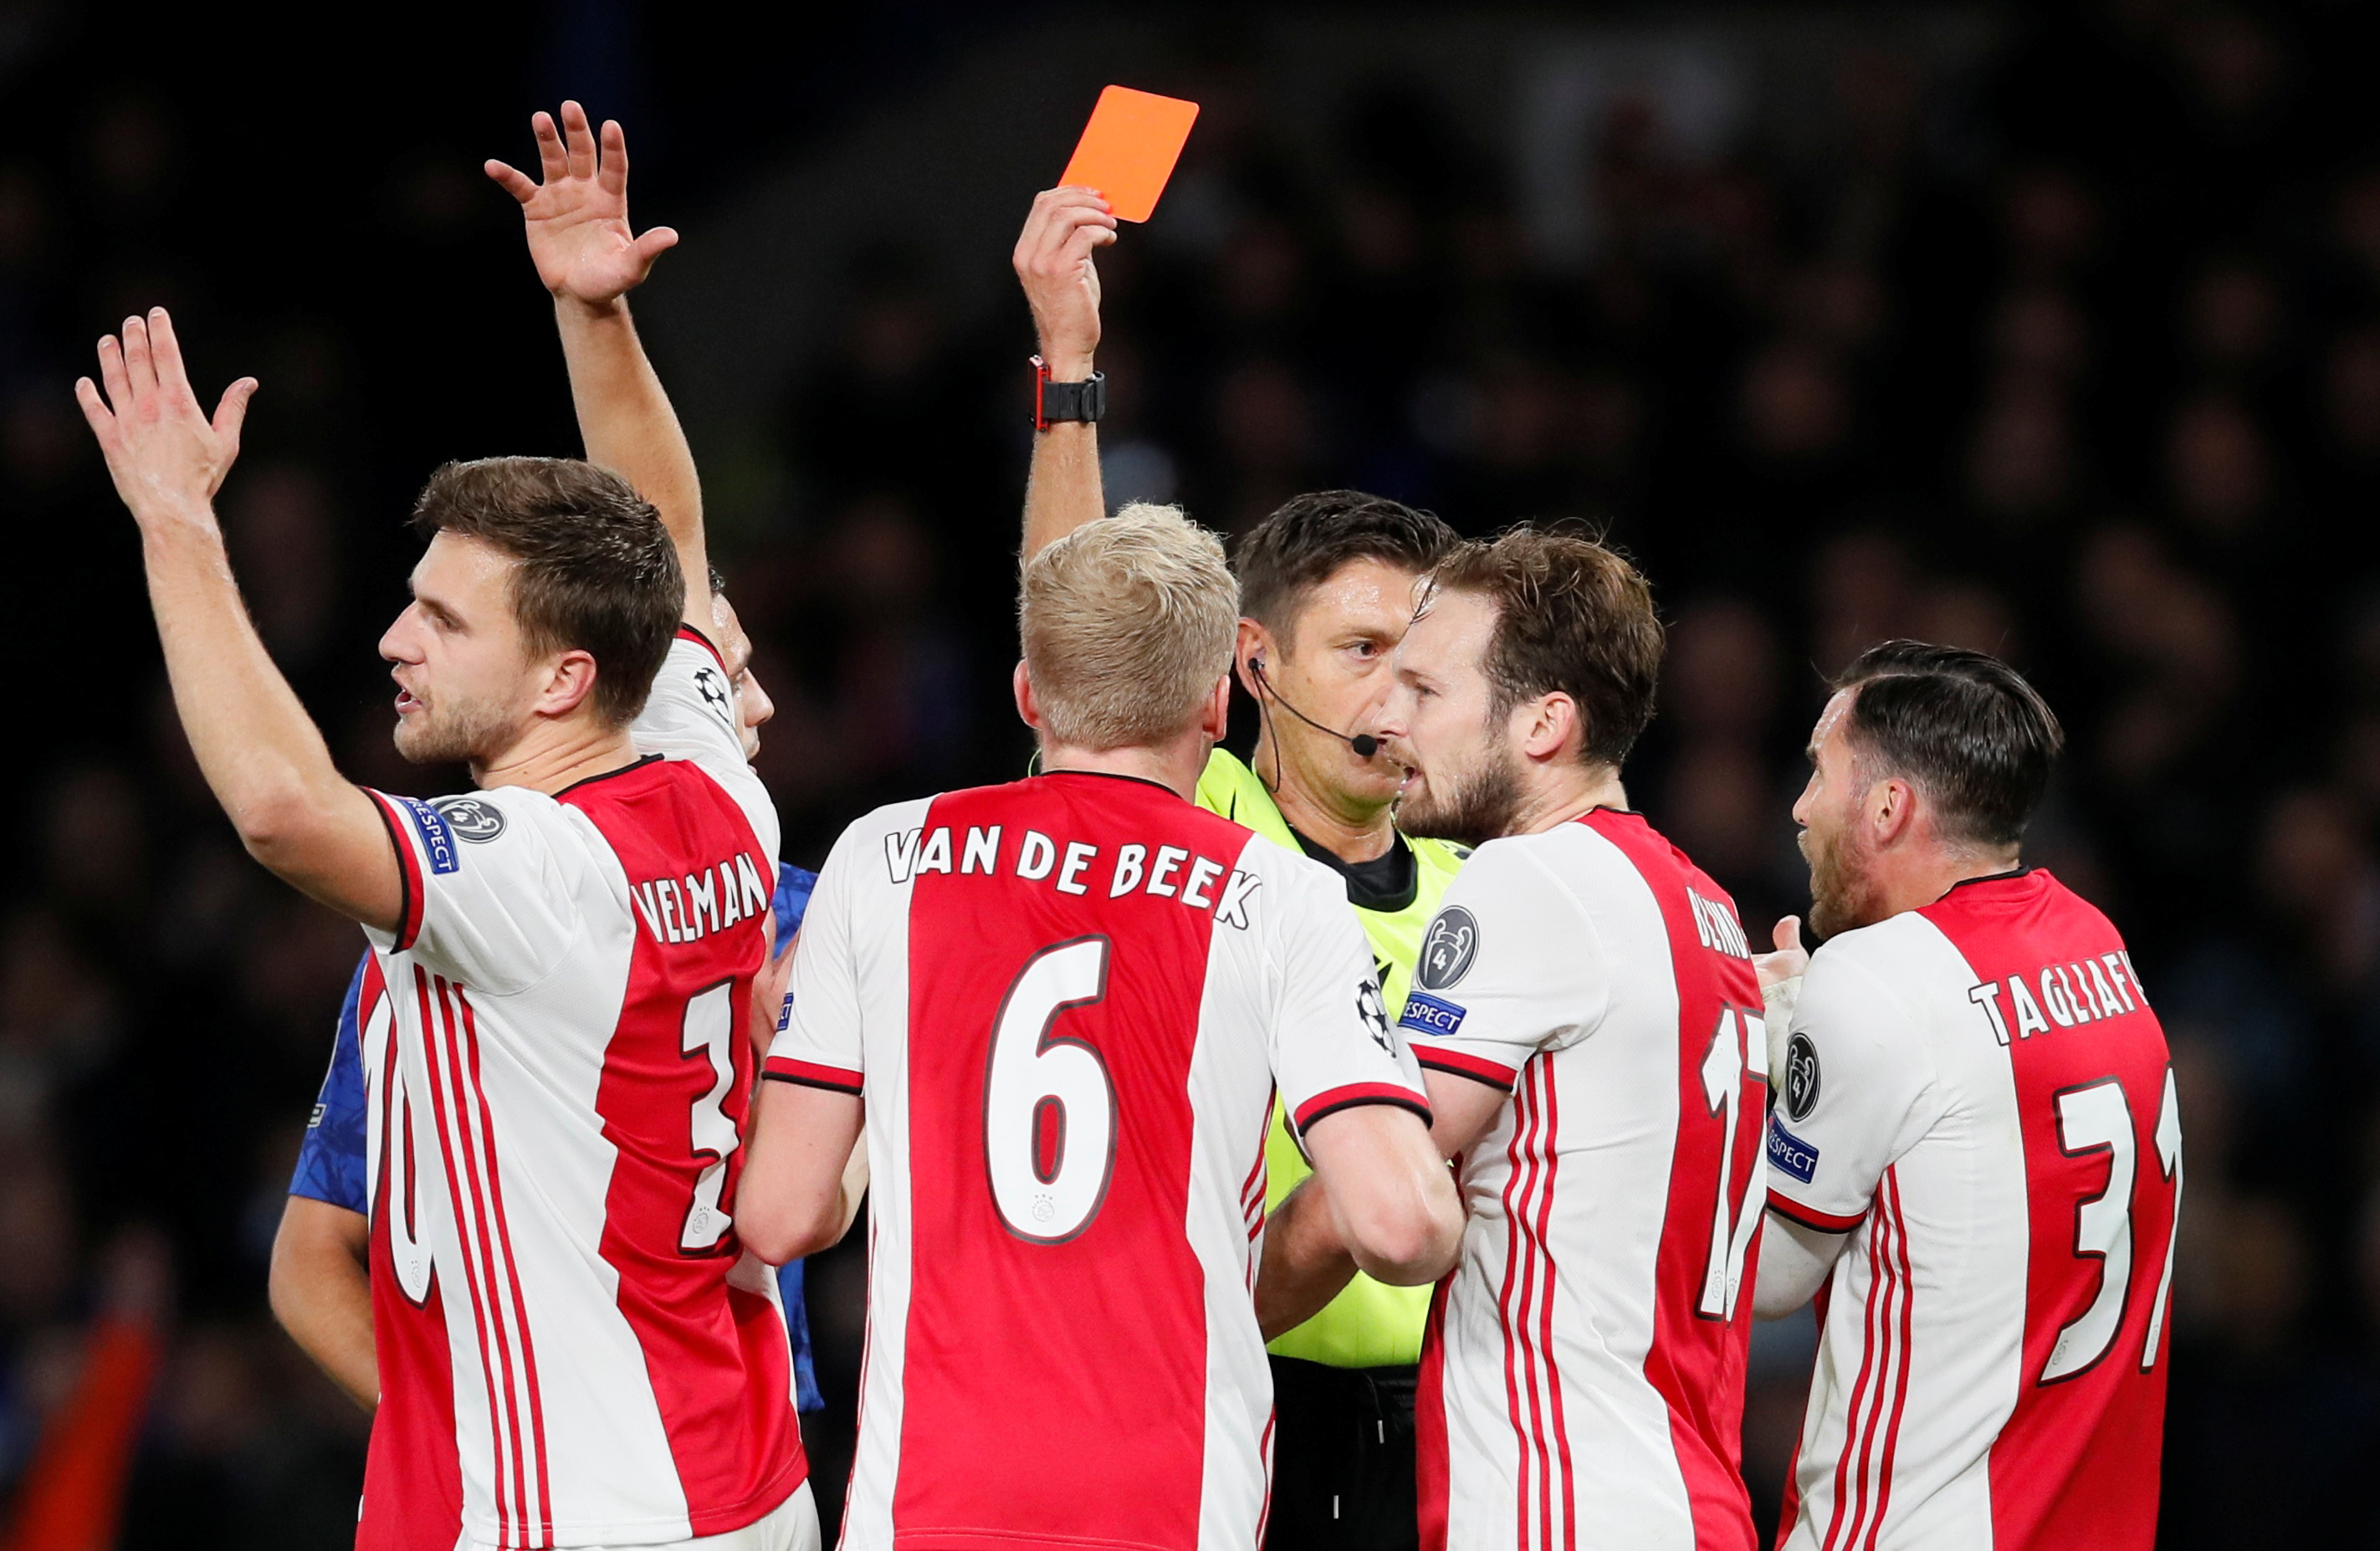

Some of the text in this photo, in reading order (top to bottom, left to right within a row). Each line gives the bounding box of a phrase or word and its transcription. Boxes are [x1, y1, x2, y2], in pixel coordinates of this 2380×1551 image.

[885, 824, 1262, 929] VAN DE BEEK
[1432, 947, 1446, 970] 4
[1404, 1001, 1461, 1031] ESPECT
[678, 975, 741, 1255] 3
[982, 933, 1117, 1245] 6
[1792, 1075, 1801, 1098] 4
[2036, 1059, 2184, 1387] 31
